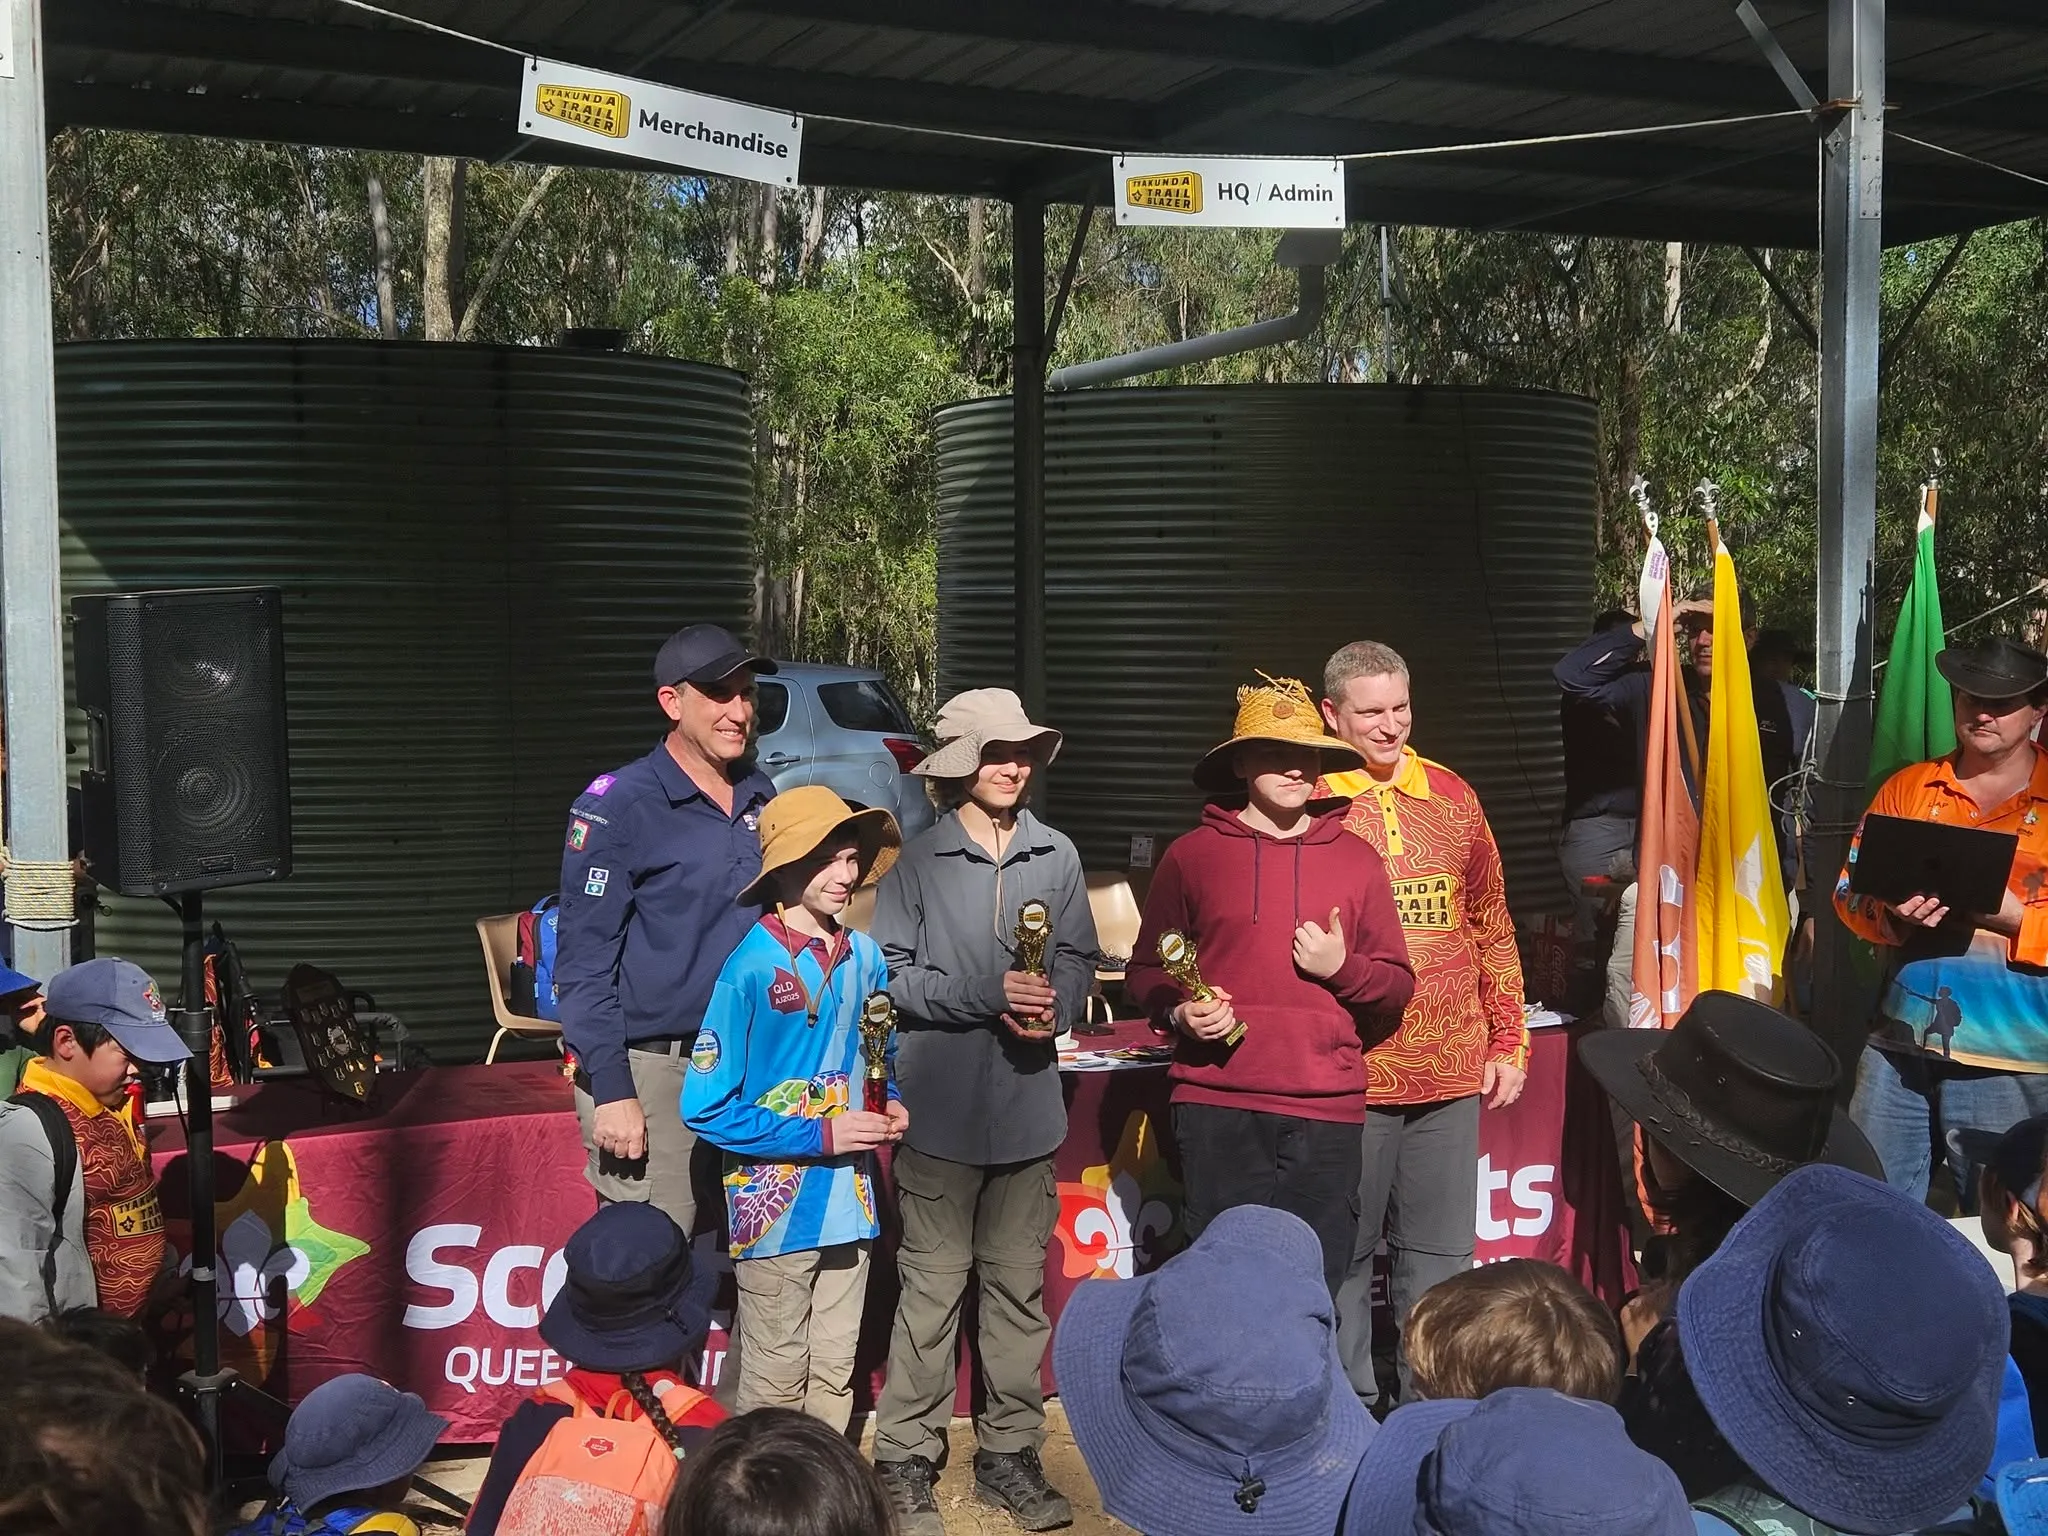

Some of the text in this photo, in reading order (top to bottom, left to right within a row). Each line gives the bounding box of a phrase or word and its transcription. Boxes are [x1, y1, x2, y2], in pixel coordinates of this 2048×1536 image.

[545, 88, 616, 106] TYAKUNDA
[561, 100, 613, 120] TRAIL
[560, 109, 613, 131] BLAZER
[638, 108, 789, 159] Merchandise
[1133, 177, 1190, 187] TYAKUNDA
[1147, 188, 1190, 198] TRAIL
[1218, 182, 1249, 206] HQ
[1269, 183, 1333, 202] Admin
[1147, 197, 1190, 209] BLAZER
[1392, 879, 1447, 896] UNDA
[1396, 895, 1447, 911] RAIL
[1401, 911, 1449, 925] AZER
[773, 981, 794, 994] QLD
[775, 992, 800, 1005] AJ2025
